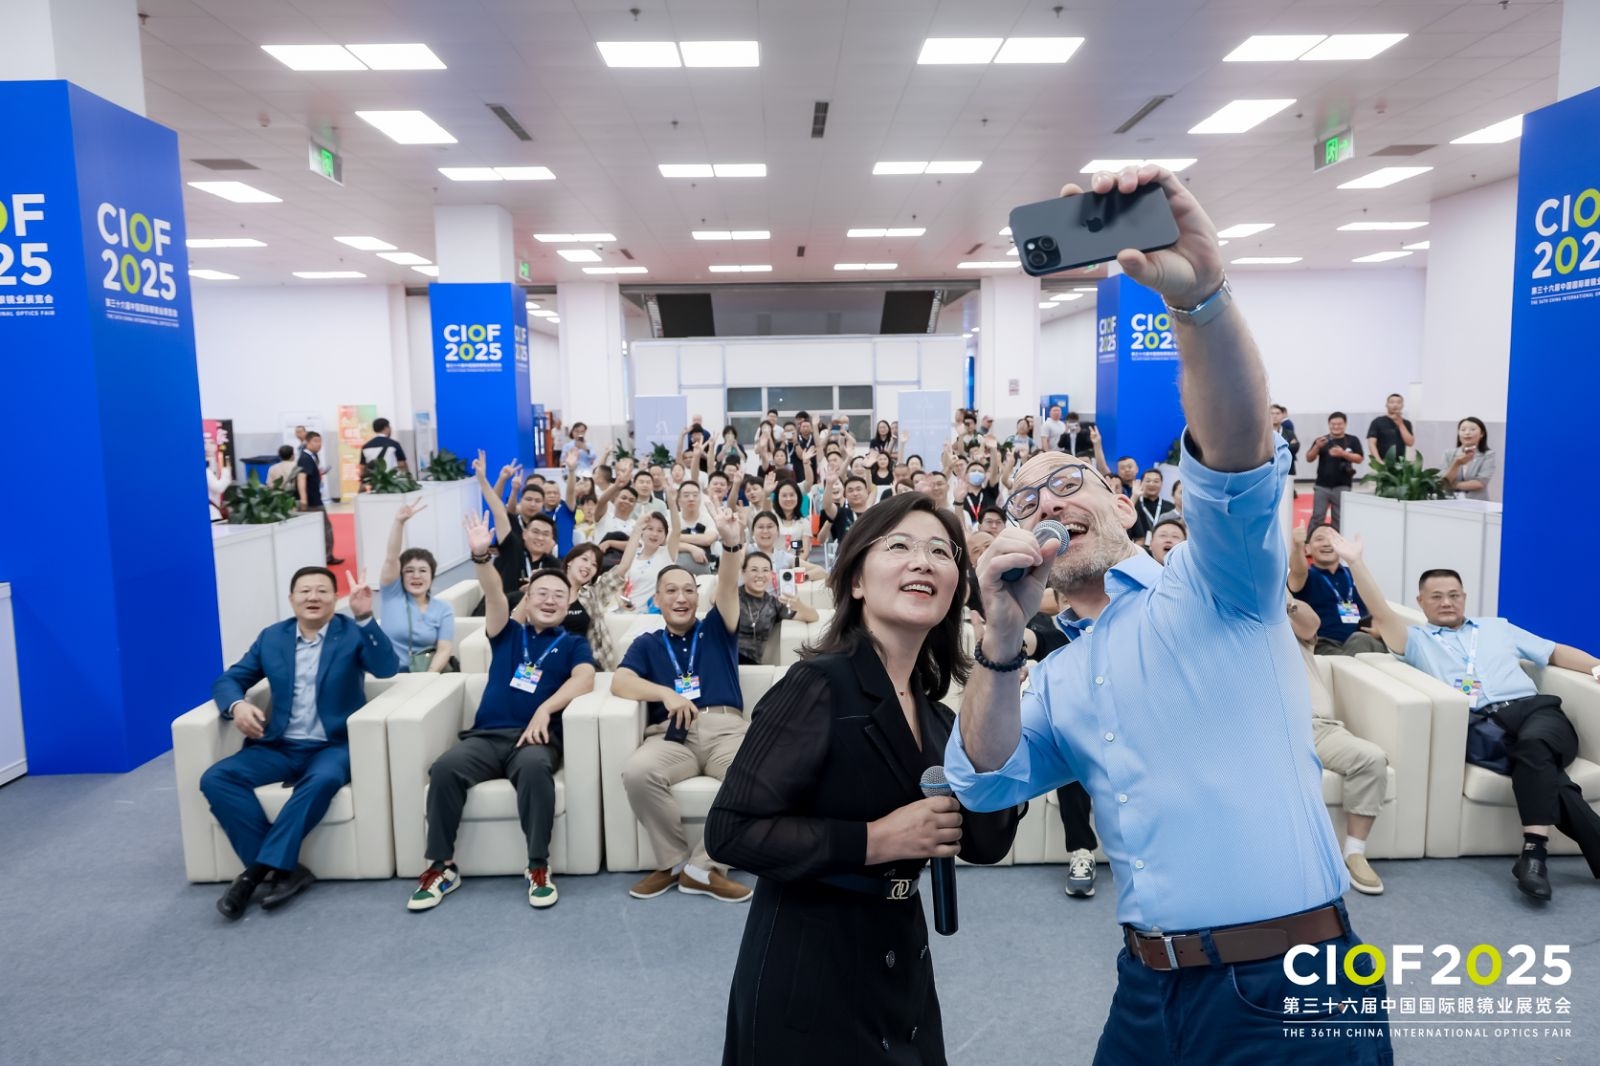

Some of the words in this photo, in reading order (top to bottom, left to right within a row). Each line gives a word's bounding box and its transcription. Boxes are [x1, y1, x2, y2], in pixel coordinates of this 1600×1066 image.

[97, 202, 171, 256] CIOF
[101, 249, 177, 301] 2025
[443, 324, 502, 342] CIOF
[445, 342, 503, 361] 2025
